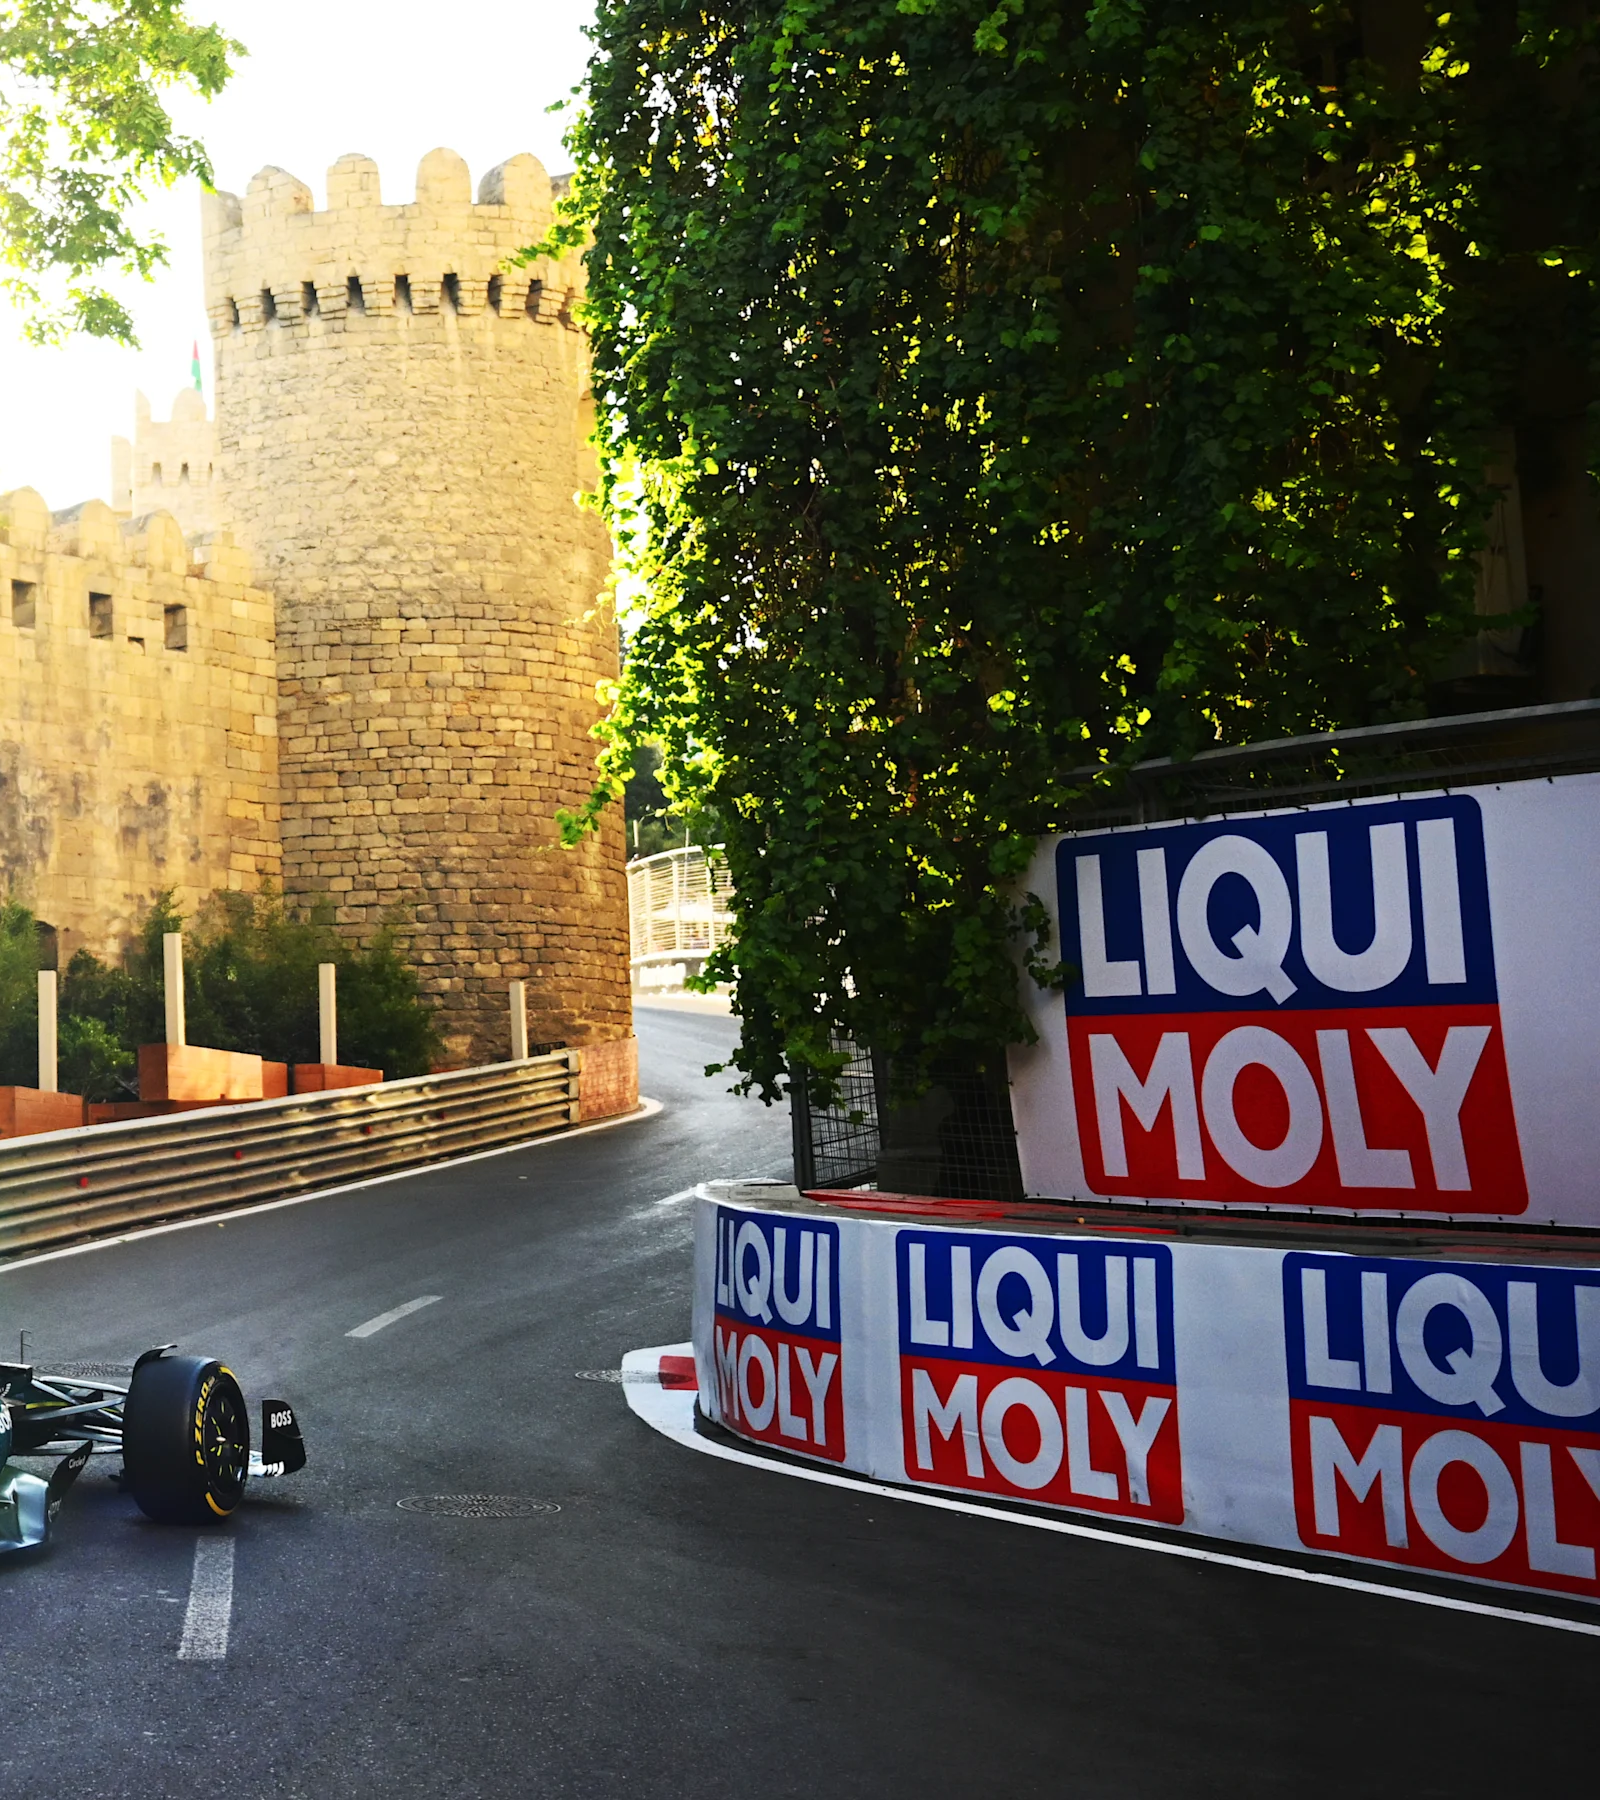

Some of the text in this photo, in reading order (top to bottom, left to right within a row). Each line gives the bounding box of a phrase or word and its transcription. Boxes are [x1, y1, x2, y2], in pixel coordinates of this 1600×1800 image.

[1075, 817, 1467, 1005] LIQUI
[1087, 1025, 1492, 1191] MOLY
[716, 1216, 831, 1330] LIQUI
[908, 1243, 1160, 1369] LIQUI
[194, 1381, 209, 1445] ZERO
[270, 1409, 292, 1428] BOSS
[715, 1324, 838, 1447] MOLY
[911, 1368, 1173, 1506] MOLY
